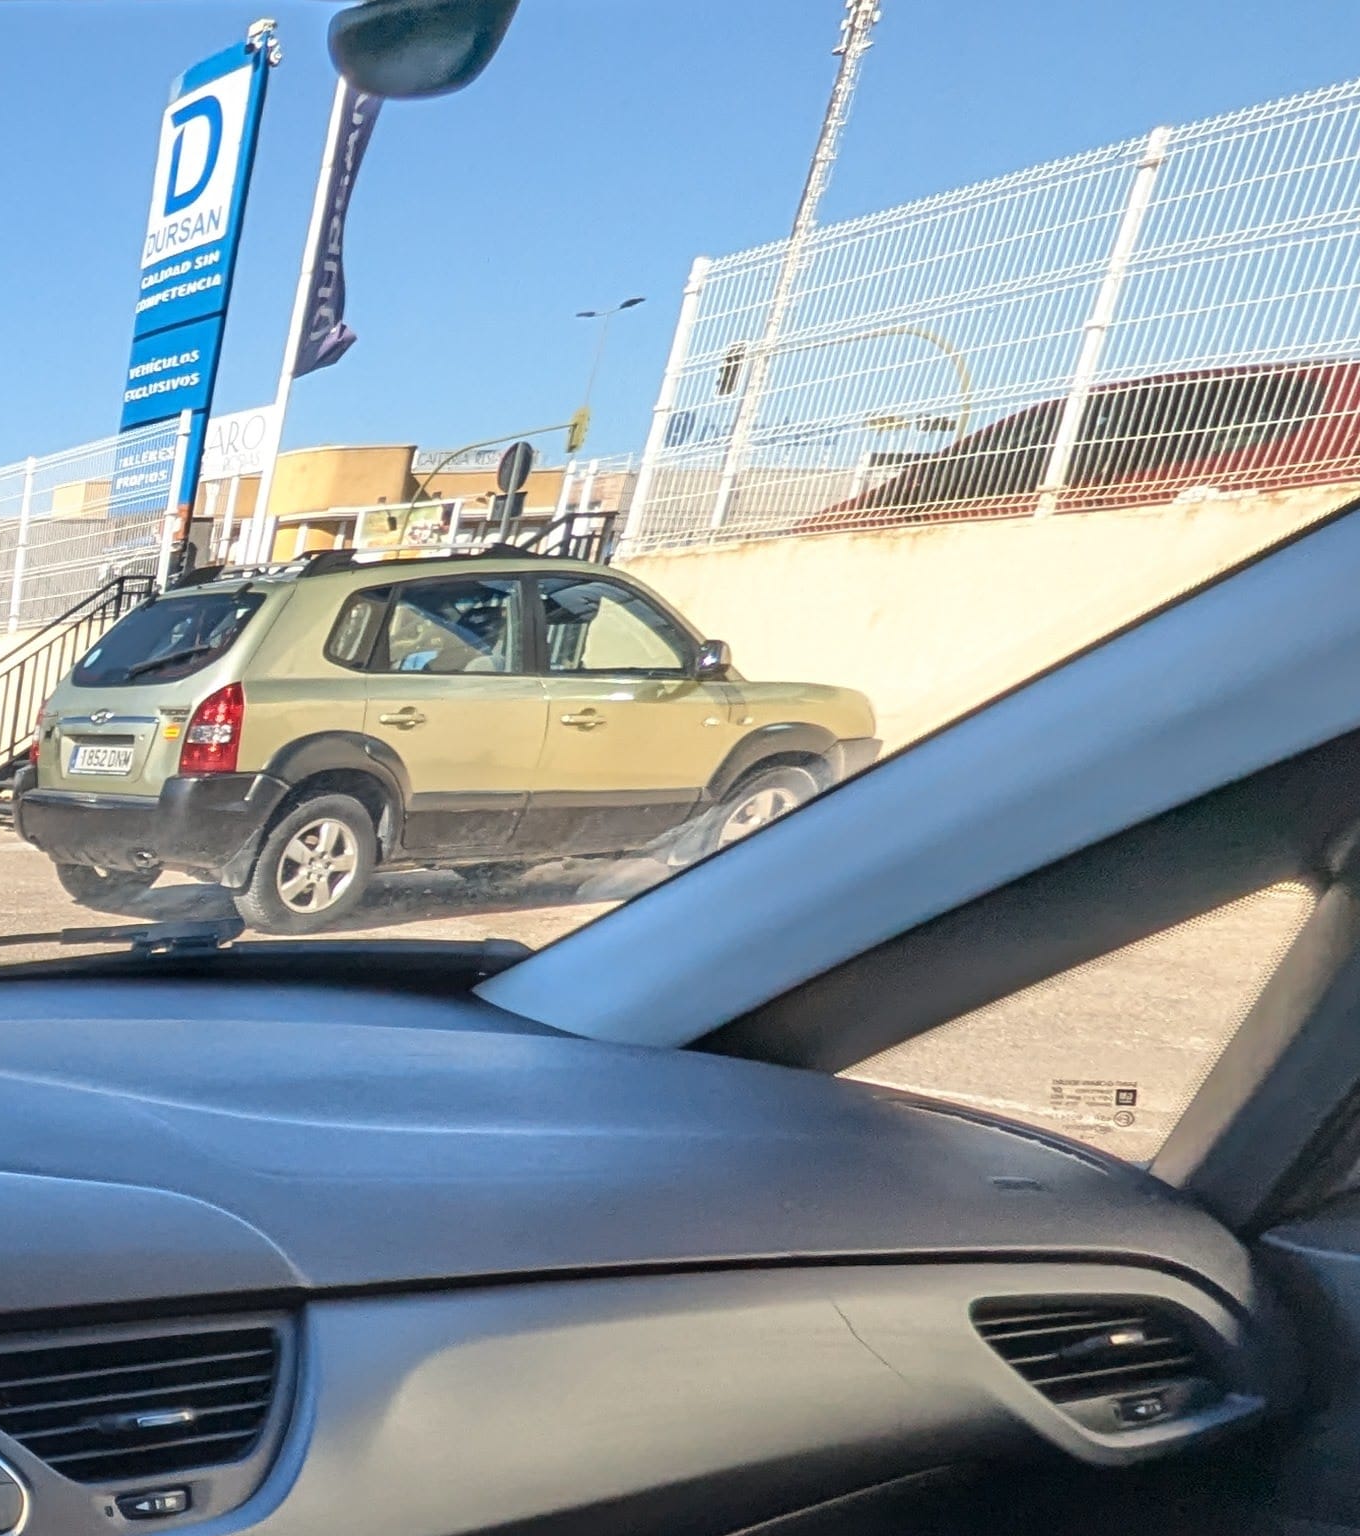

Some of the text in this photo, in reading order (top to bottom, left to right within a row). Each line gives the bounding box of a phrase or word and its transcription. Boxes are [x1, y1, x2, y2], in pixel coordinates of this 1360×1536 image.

[146, 206, 222, 259] DURSAN
[141, 250, 220, 289] CALIDAD SIN
[136, 273, 222, 313] COMPETENCIA
[124, 372, 200, 402] EXCLUSIVOS
[81, 749, 107, 767] 1852
